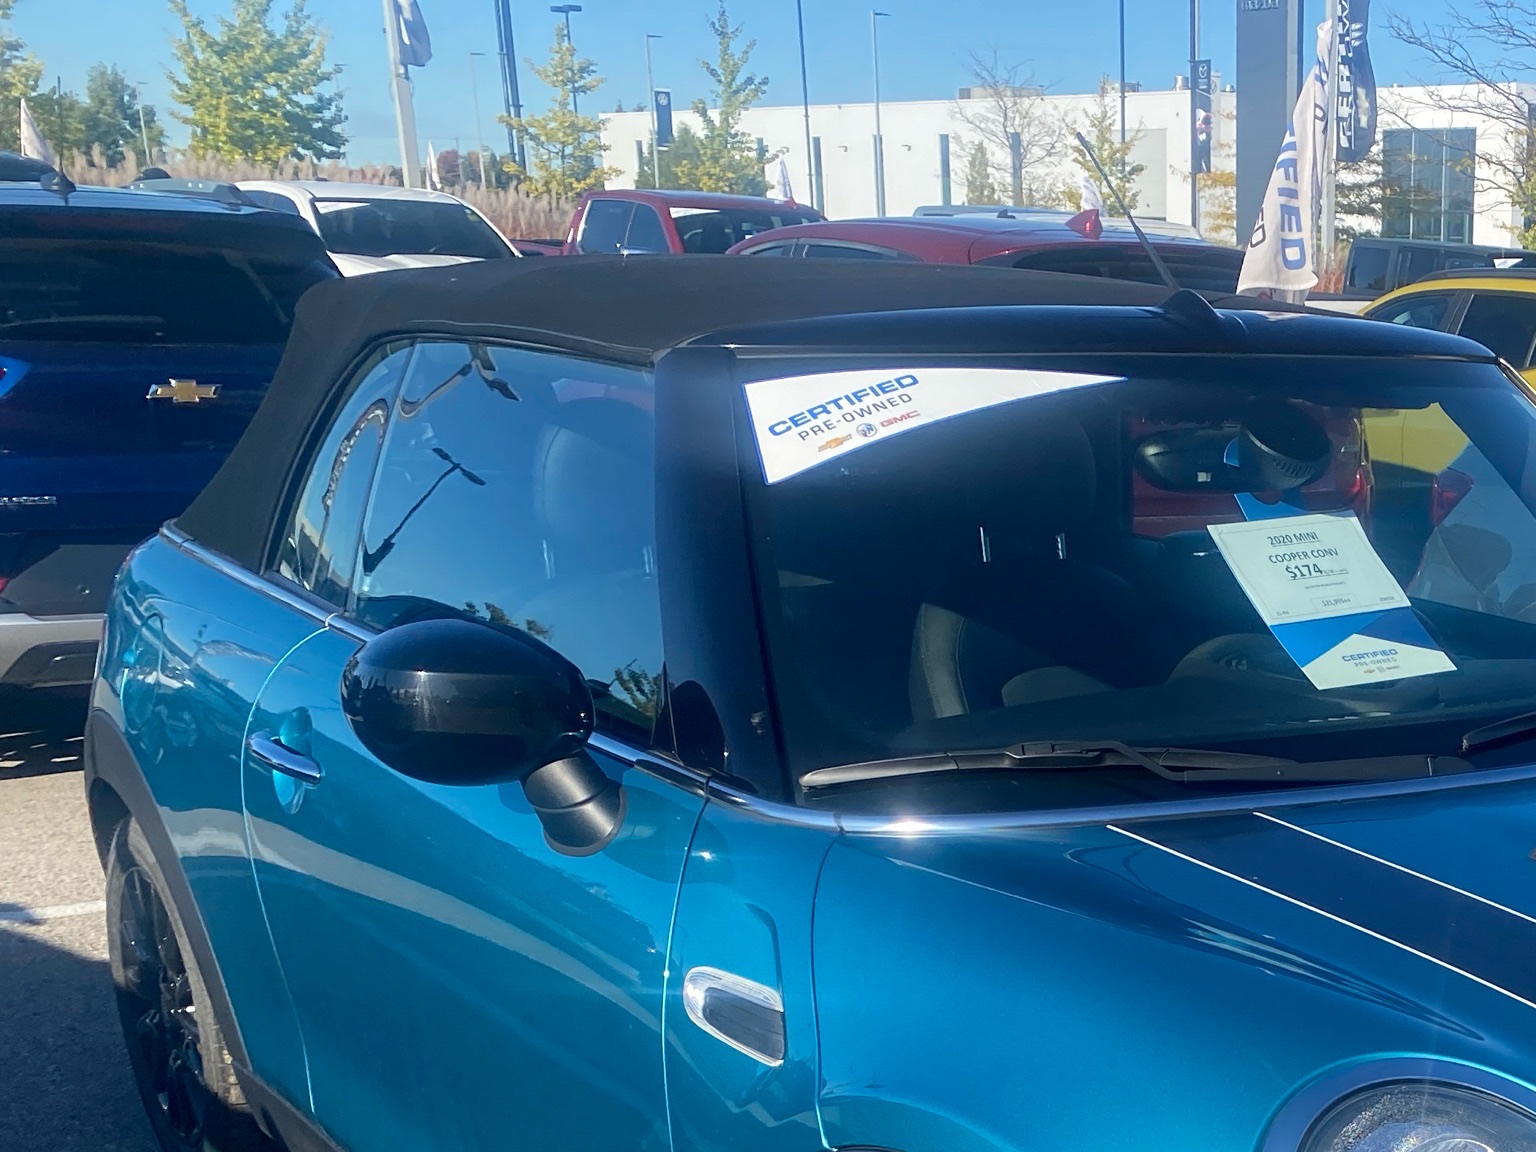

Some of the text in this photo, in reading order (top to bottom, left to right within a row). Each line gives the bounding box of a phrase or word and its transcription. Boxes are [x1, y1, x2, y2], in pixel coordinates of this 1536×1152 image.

[768, 374, 919, 436] CERTIFIED
[798, 393, 912, 441] PRE-OWNED
[880, 410, 921, 428] GMC
[1267, 531, 1319, 545] 2020 MINI
[1268, 547, 1339, 564] COOPER CONV
[1285, 563, 1323, 580] $174
[1342, 649, 1398, 662] CERTIFIED
